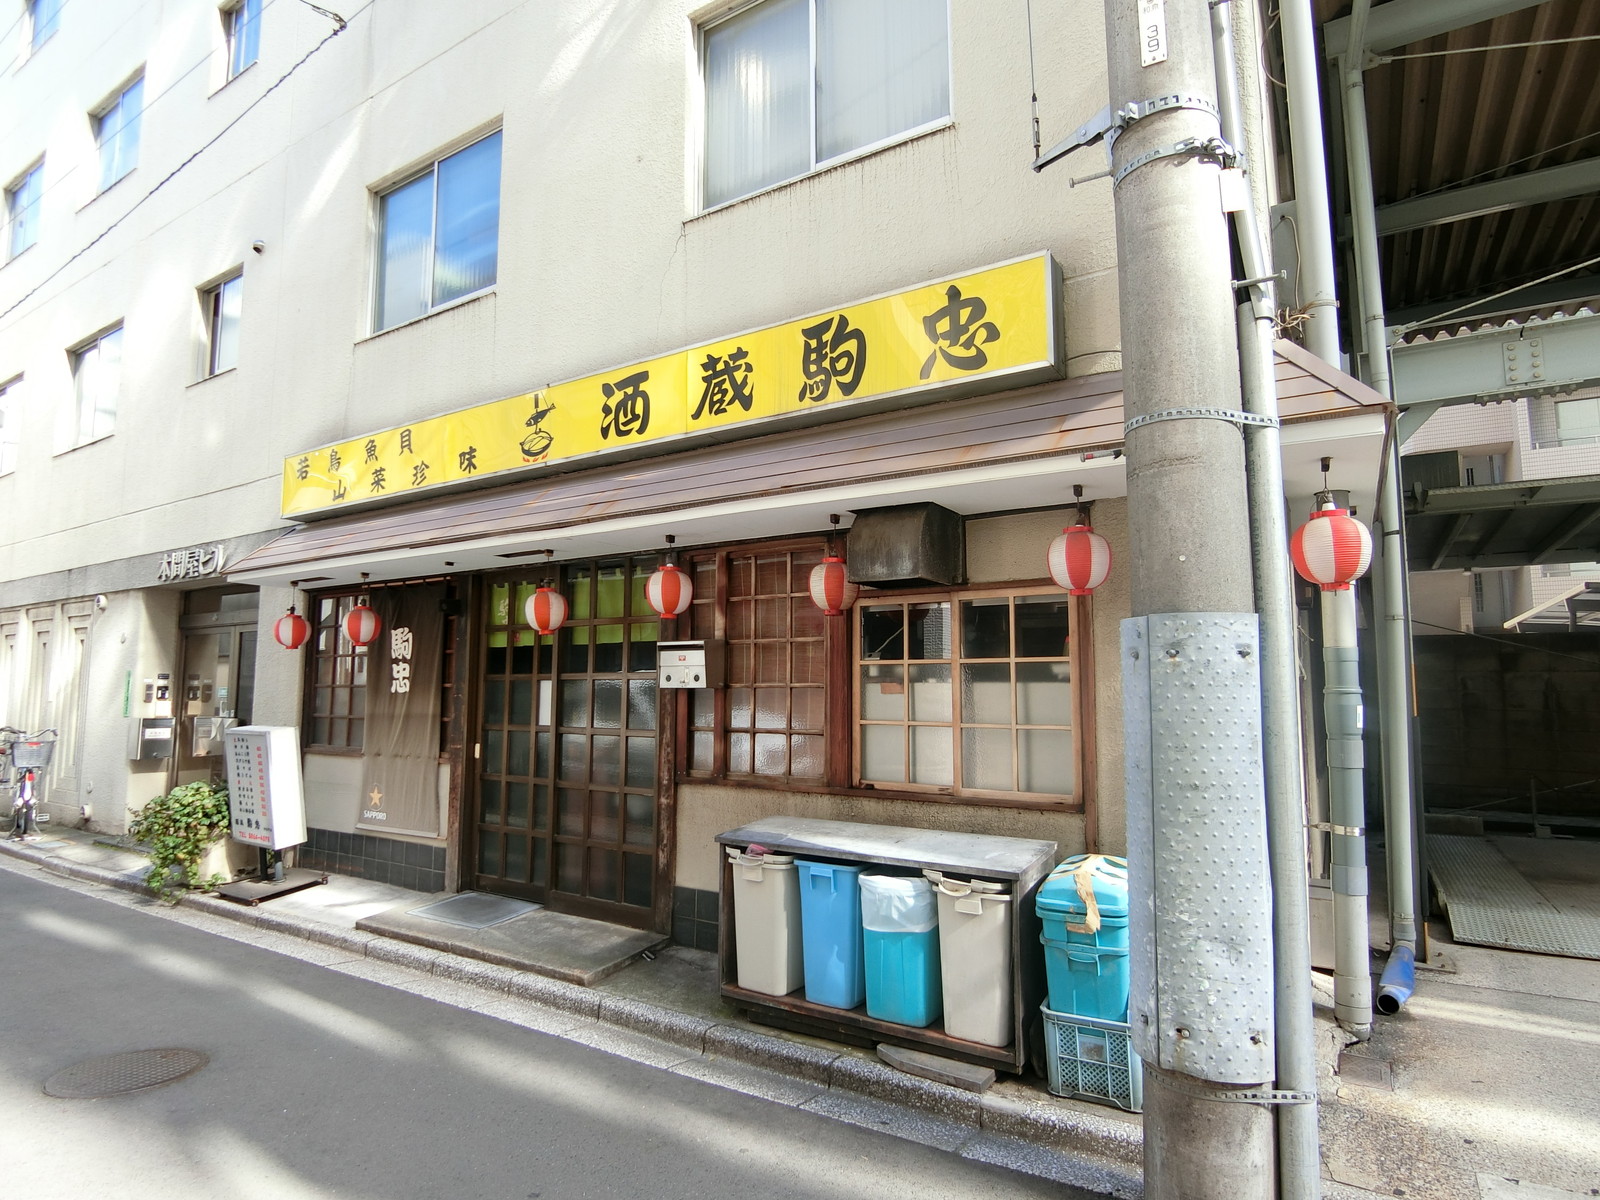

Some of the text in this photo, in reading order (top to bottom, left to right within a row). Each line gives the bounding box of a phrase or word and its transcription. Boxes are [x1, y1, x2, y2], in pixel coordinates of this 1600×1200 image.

[1147, 24, 1160, 53] 39
[600, 284, 1000, 441] 酒蔵駒忠
[296, 428, 414, 481] 若鳥魚貝
[332, 445, 478, 502] 山菜珍味
[390, 626, 413, 694] 駒忠
[363, 809, 387, 821] SAPPORO
